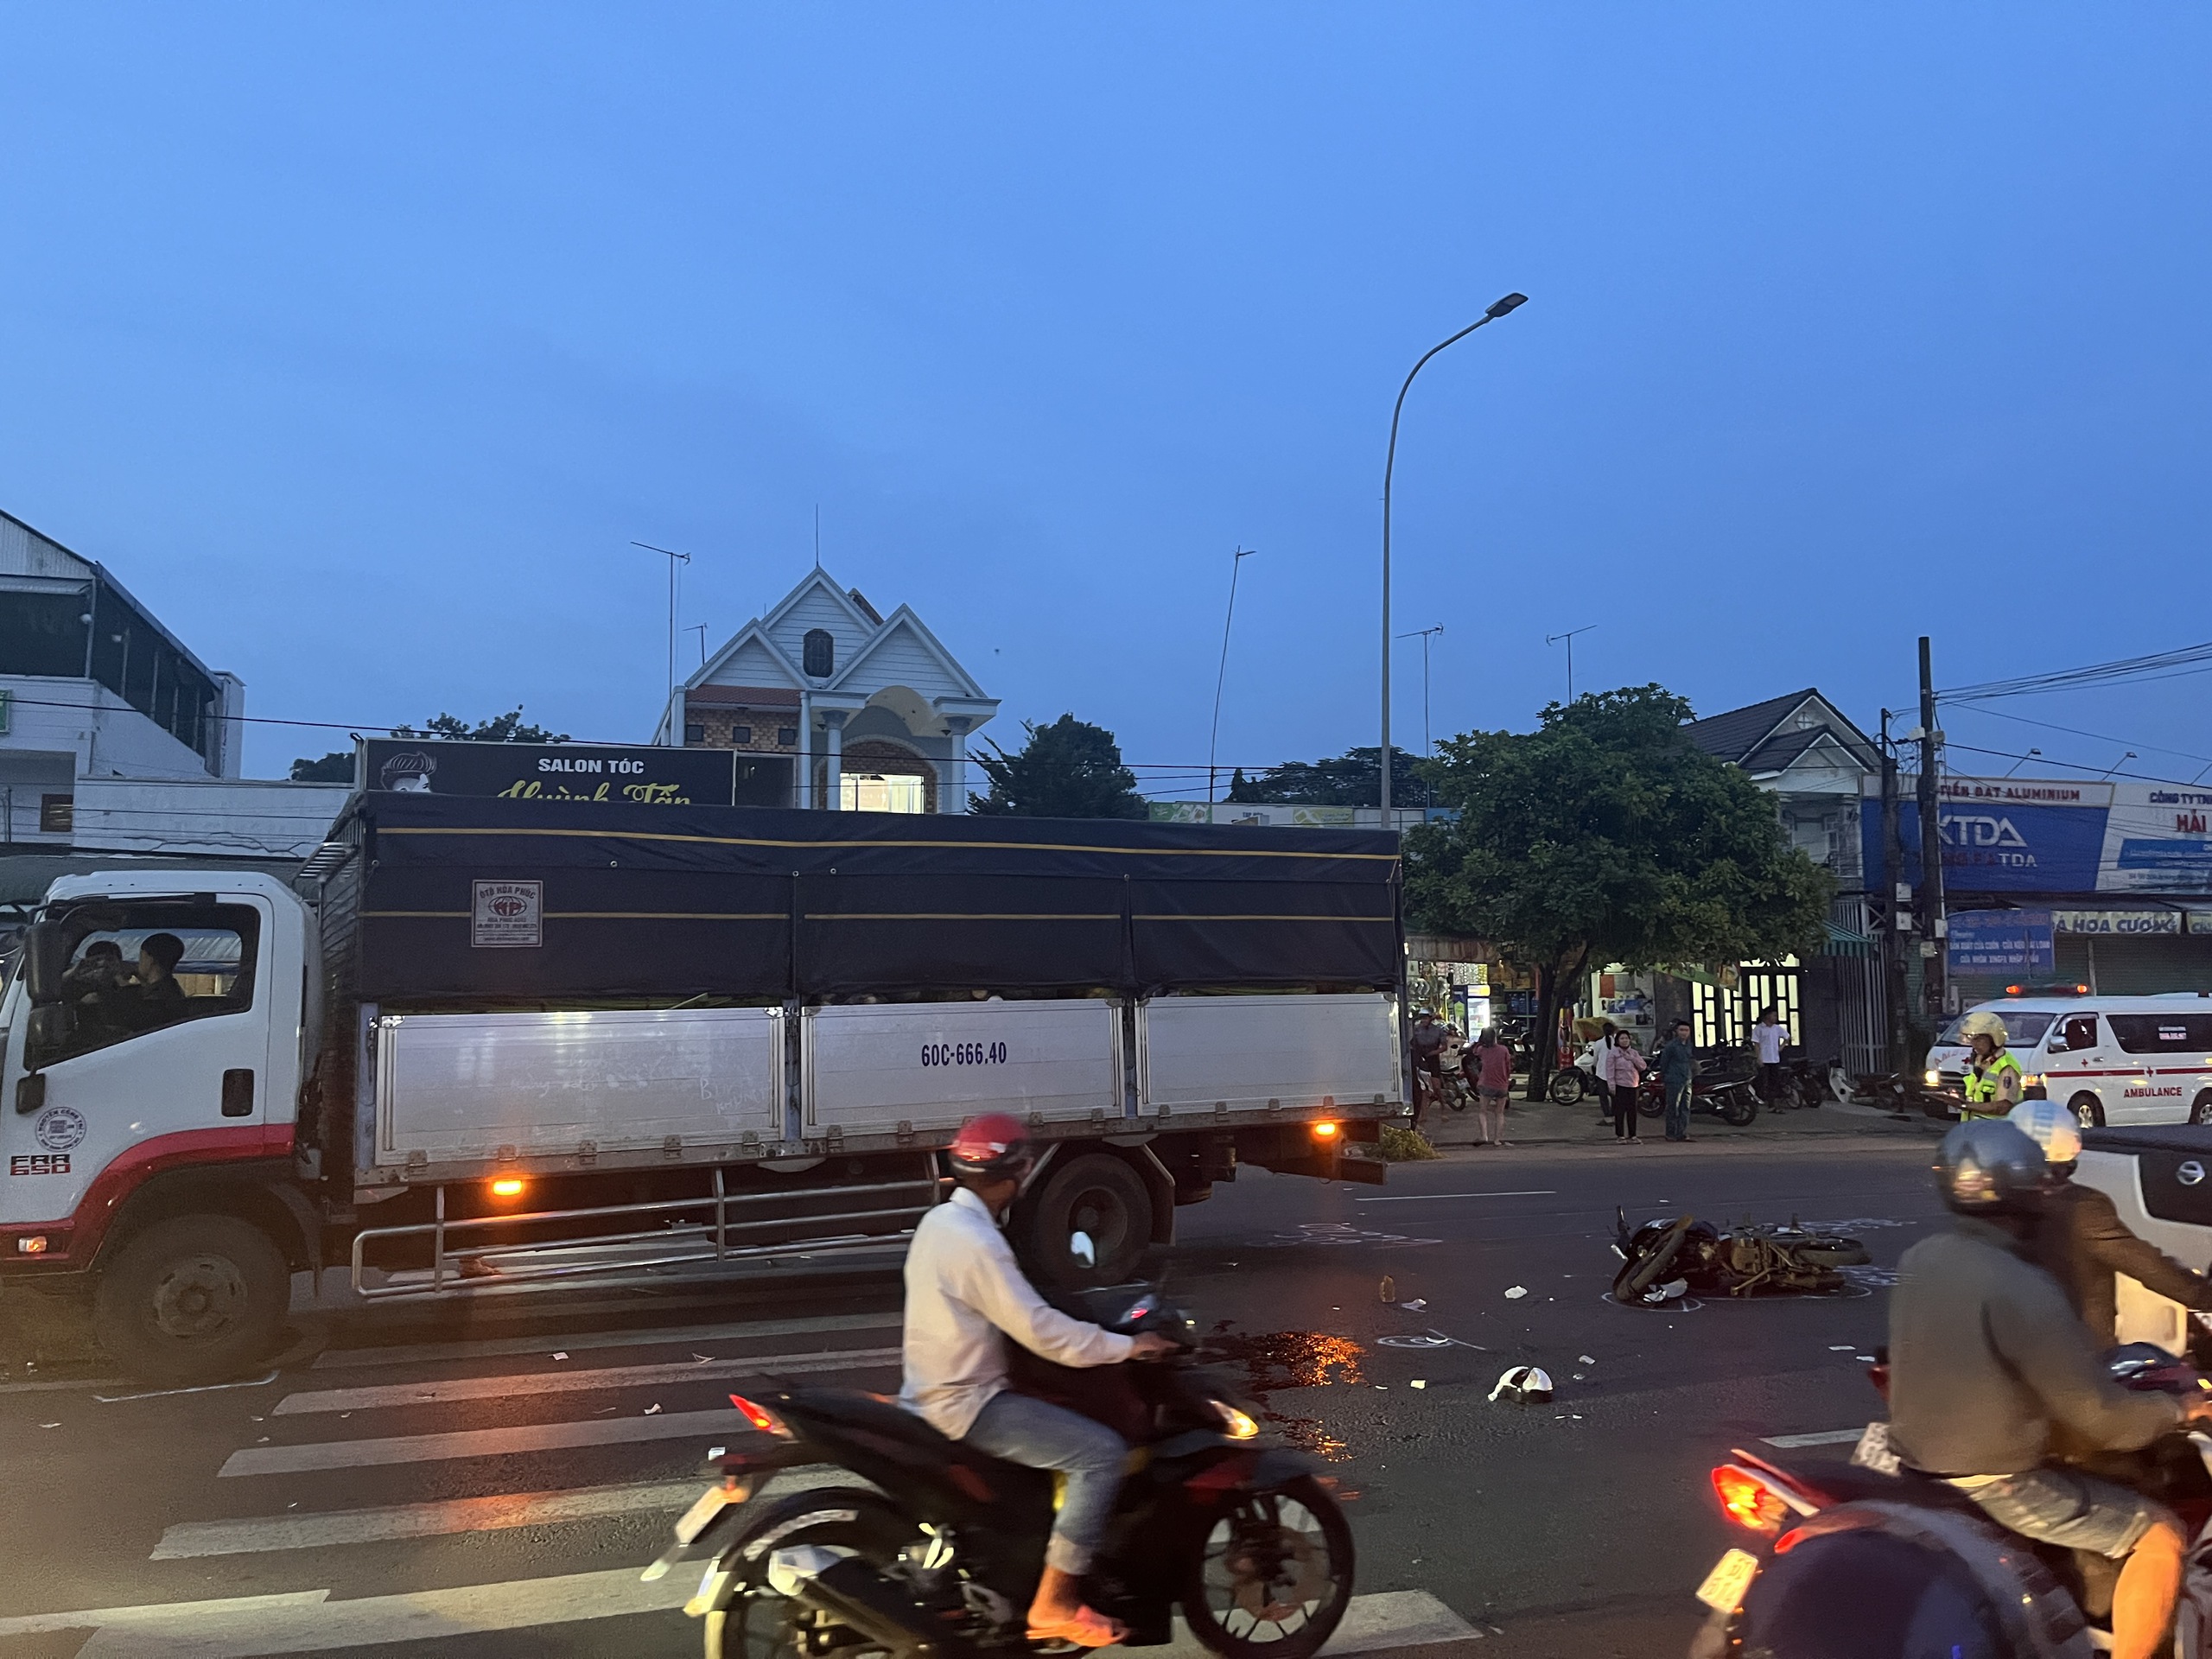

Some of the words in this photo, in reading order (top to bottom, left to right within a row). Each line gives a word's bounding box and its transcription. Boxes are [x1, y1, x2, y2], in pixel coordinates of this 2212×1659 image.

[538, 758, 602, 773] SALON
[607, 758, 645, 774] TÓC
[2006, 787, 2080, 801] ALUMINIUM
[2073, 918, 2112, 932] HOA
[921, 1042, 1007, 1066] 60C-666.40
[2123, 1087, 2183, 1098] AMBULANCE
[10, 1164, 71, 1175] 650
